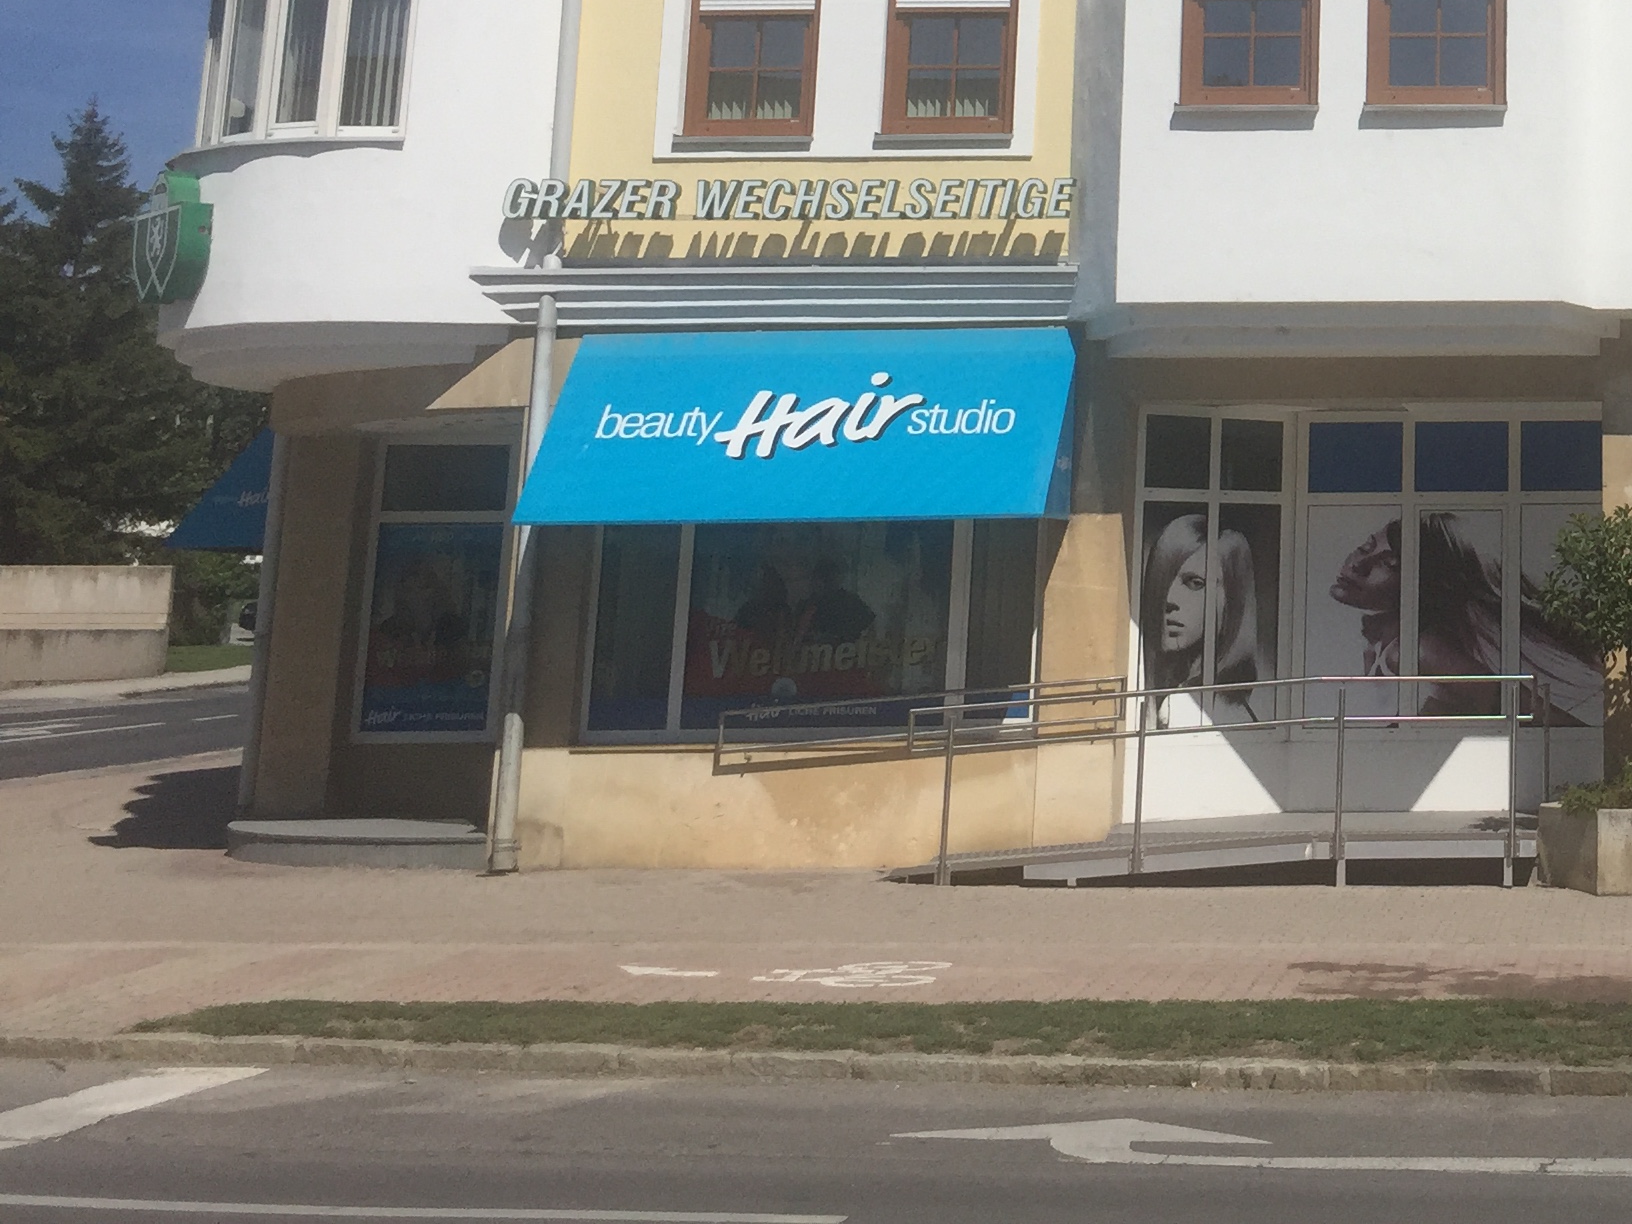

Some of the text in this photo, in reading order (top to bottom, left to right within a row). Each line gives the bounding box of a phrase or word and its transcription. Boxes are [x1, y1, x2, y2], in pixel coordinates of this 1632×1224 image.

[502, 176, 1077, 221] GRAZER WECHSELSEITIGE
[594, 371, 1017, 461] beauty Hair studio
[237, 487, 268, 508] Hai
[364, 705, 402, 726] Hair
